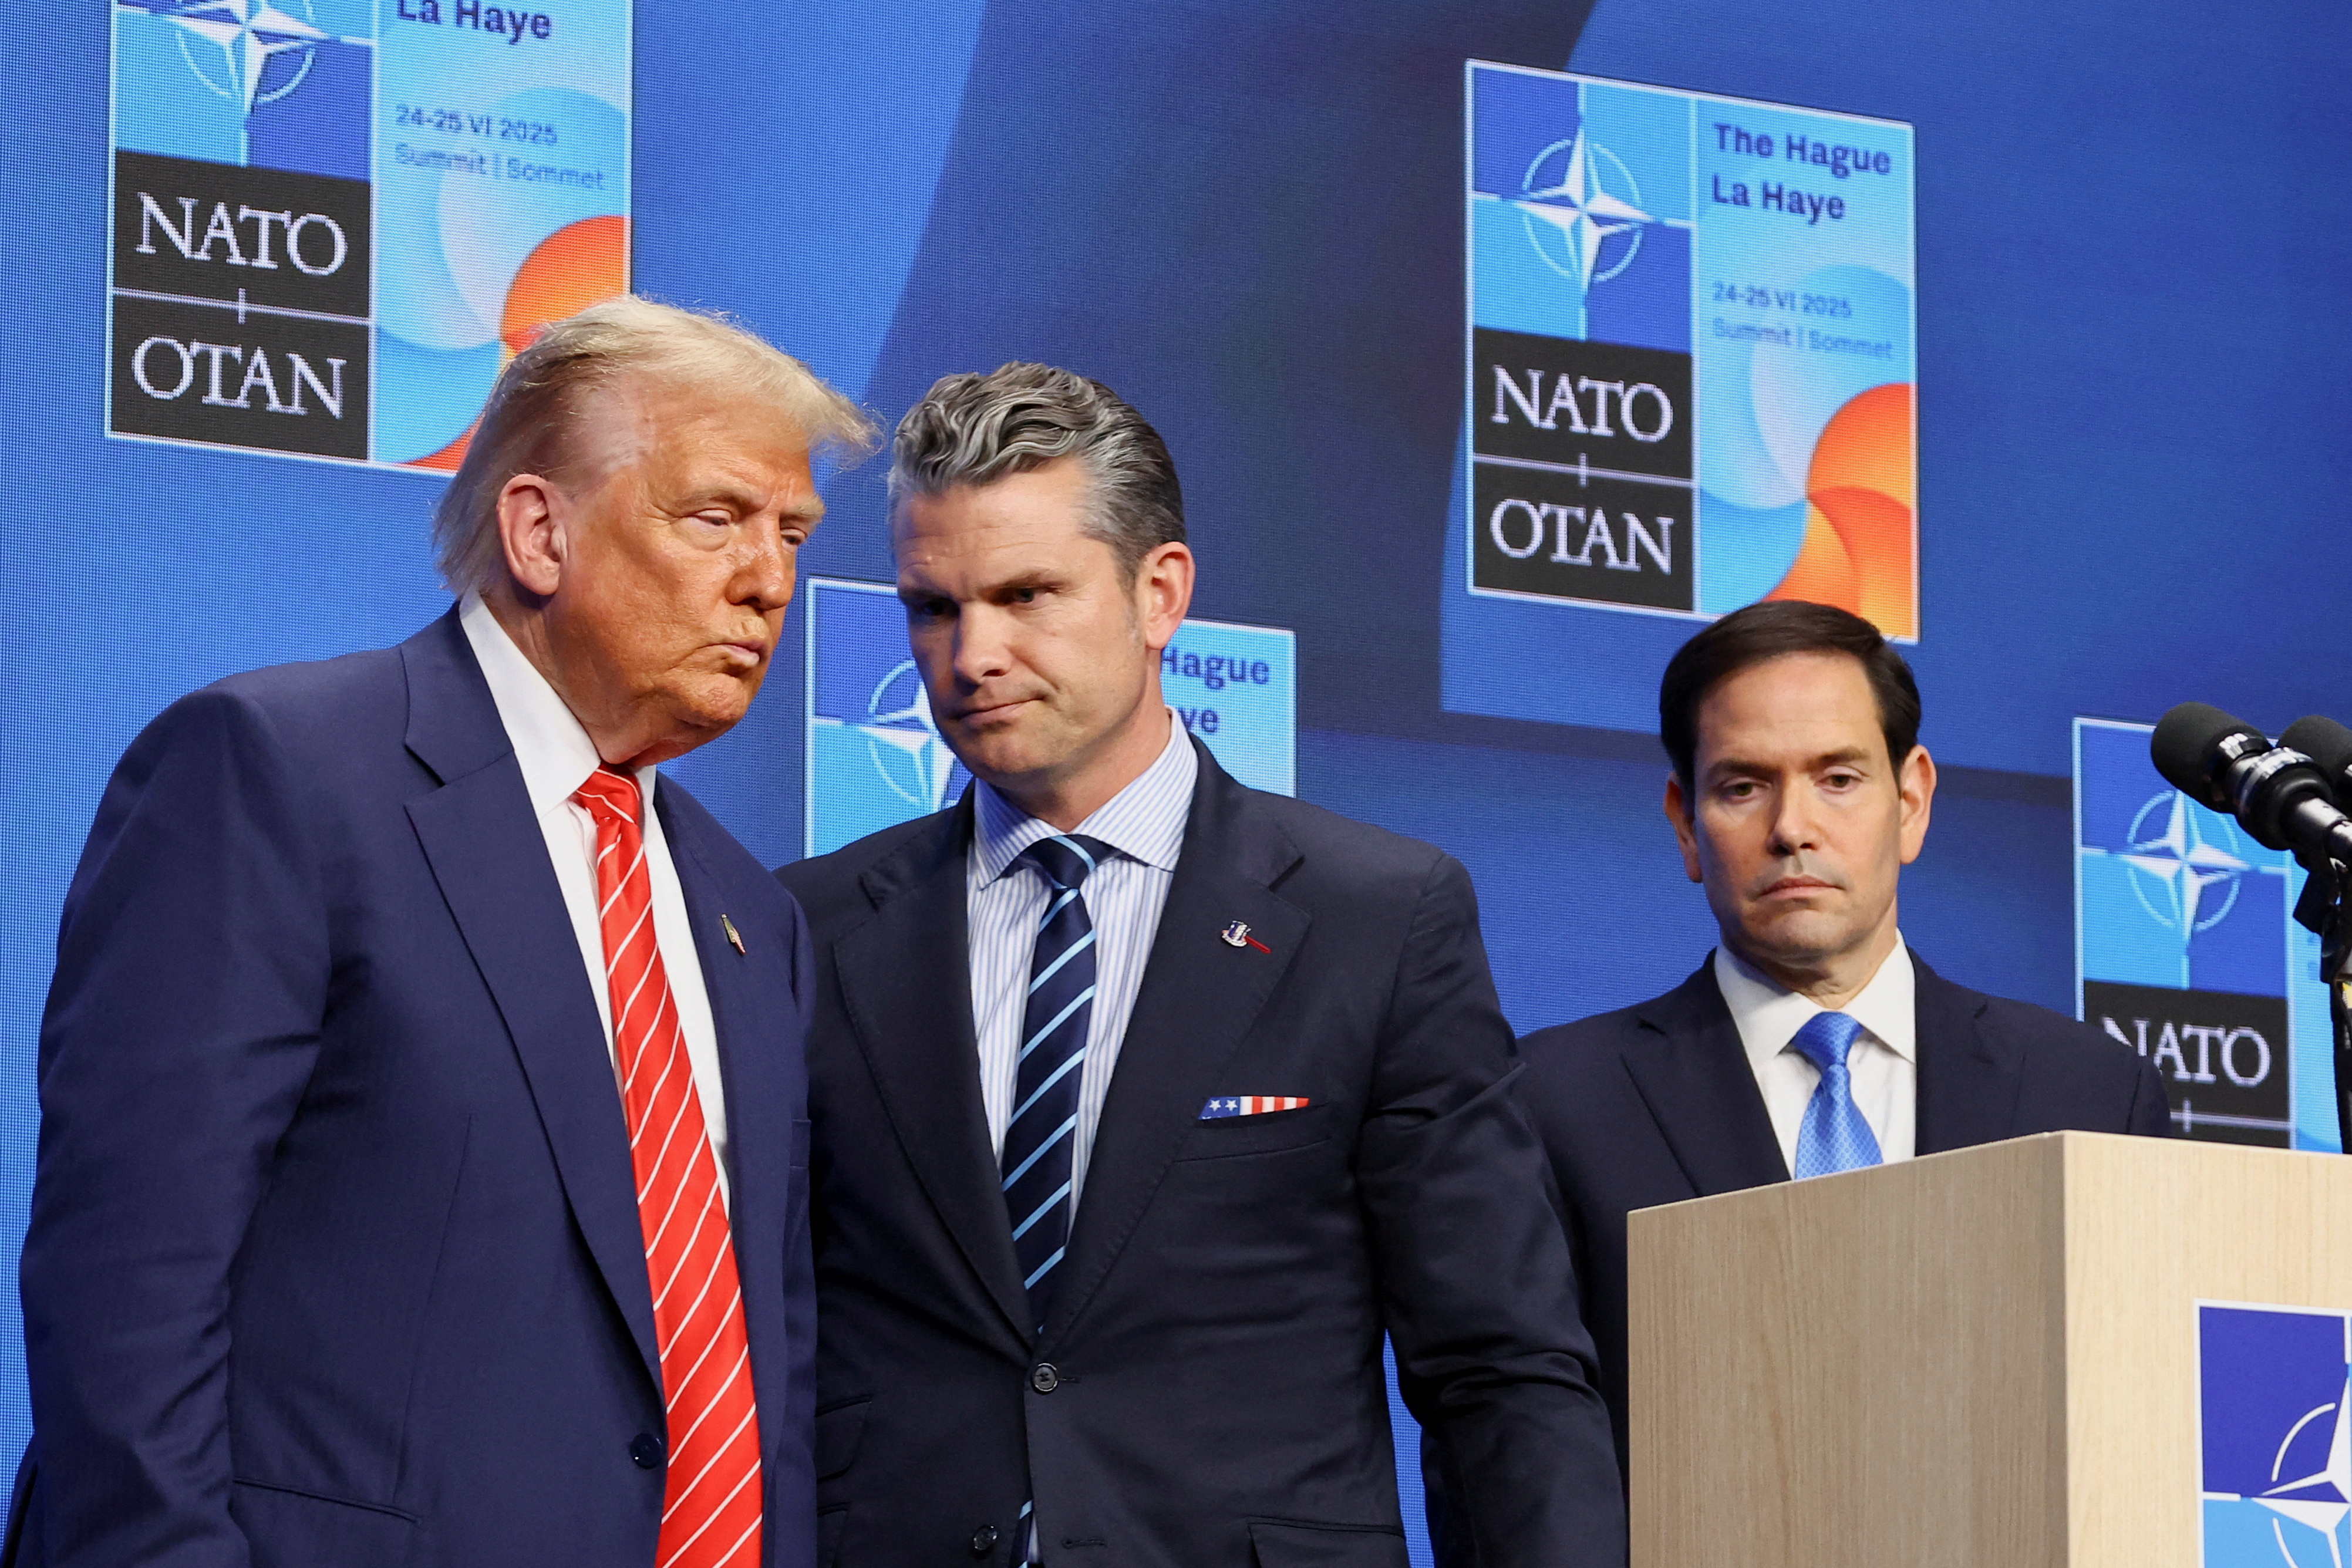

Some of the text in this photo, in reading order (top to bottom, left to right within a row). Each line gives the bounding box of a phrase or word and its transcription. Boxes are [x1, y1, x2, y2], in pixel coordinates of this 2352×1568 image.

[397, 0, 552, 45] La Haye
[396, 103, 558, 146] 24-25 VI 2025
[1714, 122, 1891, 178] The Hague
[395, 141, 486, 175] Summit
[507, 156, 603, 190] Sommet
[1712, 173, 1845, 226] La Haye
[134, 191, 348, 276] NATO
[1713, 280, 1852, 319] 24-25 VI 2025
[1713, 318, 1790, 345] Summit
[1809, 329, 1892, 358] Sommet
[131, 335, 347, 419] OTAN
[1490, 364, 1673, 443] NATO
[1488, 497, 1673, 575] OTAN
